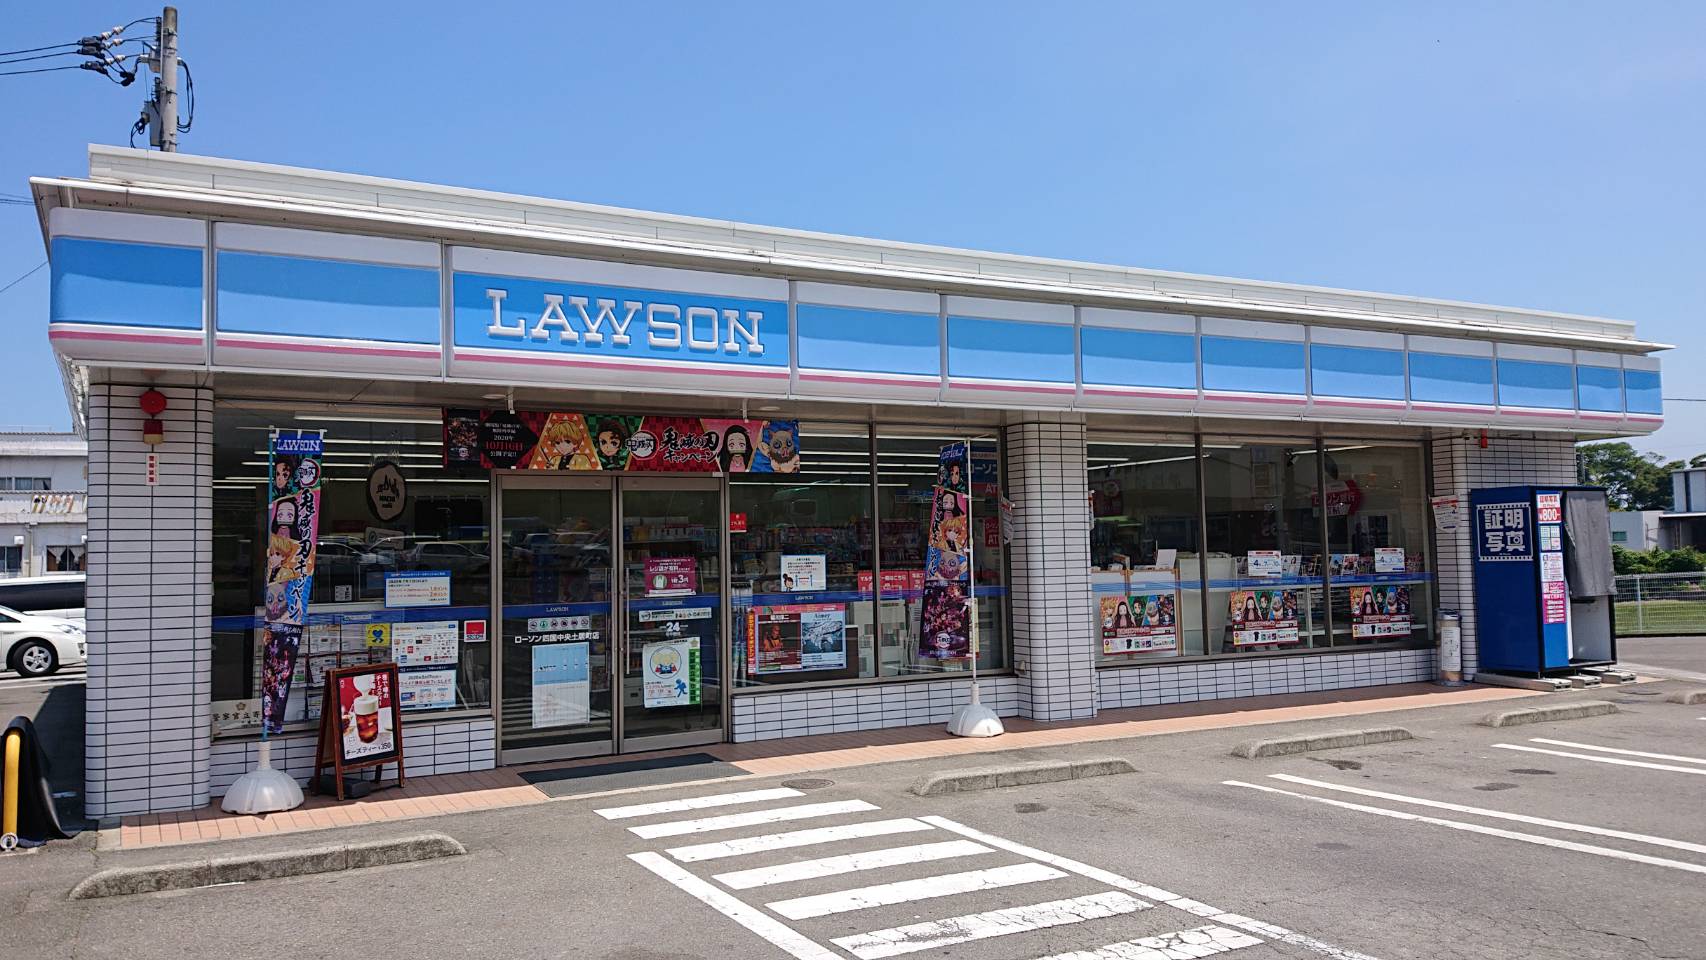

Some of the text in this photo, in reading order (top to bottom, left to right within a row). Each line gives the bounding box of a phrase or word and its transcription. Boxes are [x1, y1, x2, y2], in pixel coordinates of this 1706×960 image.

[486, 288, 765, 354] LAWSON
[276, 439, 321, 452] LAWSON
[660, 426, 719, 451] 鬼滅の刃
[663, 449, 717, 463] キャンペーン
[1484, 509, 1524, 530] 証明
[1485, 531, 1526, 553] 写真
[665, 621, 681, 632] 24
[212, 710, 260, 722] 警察官立寄
